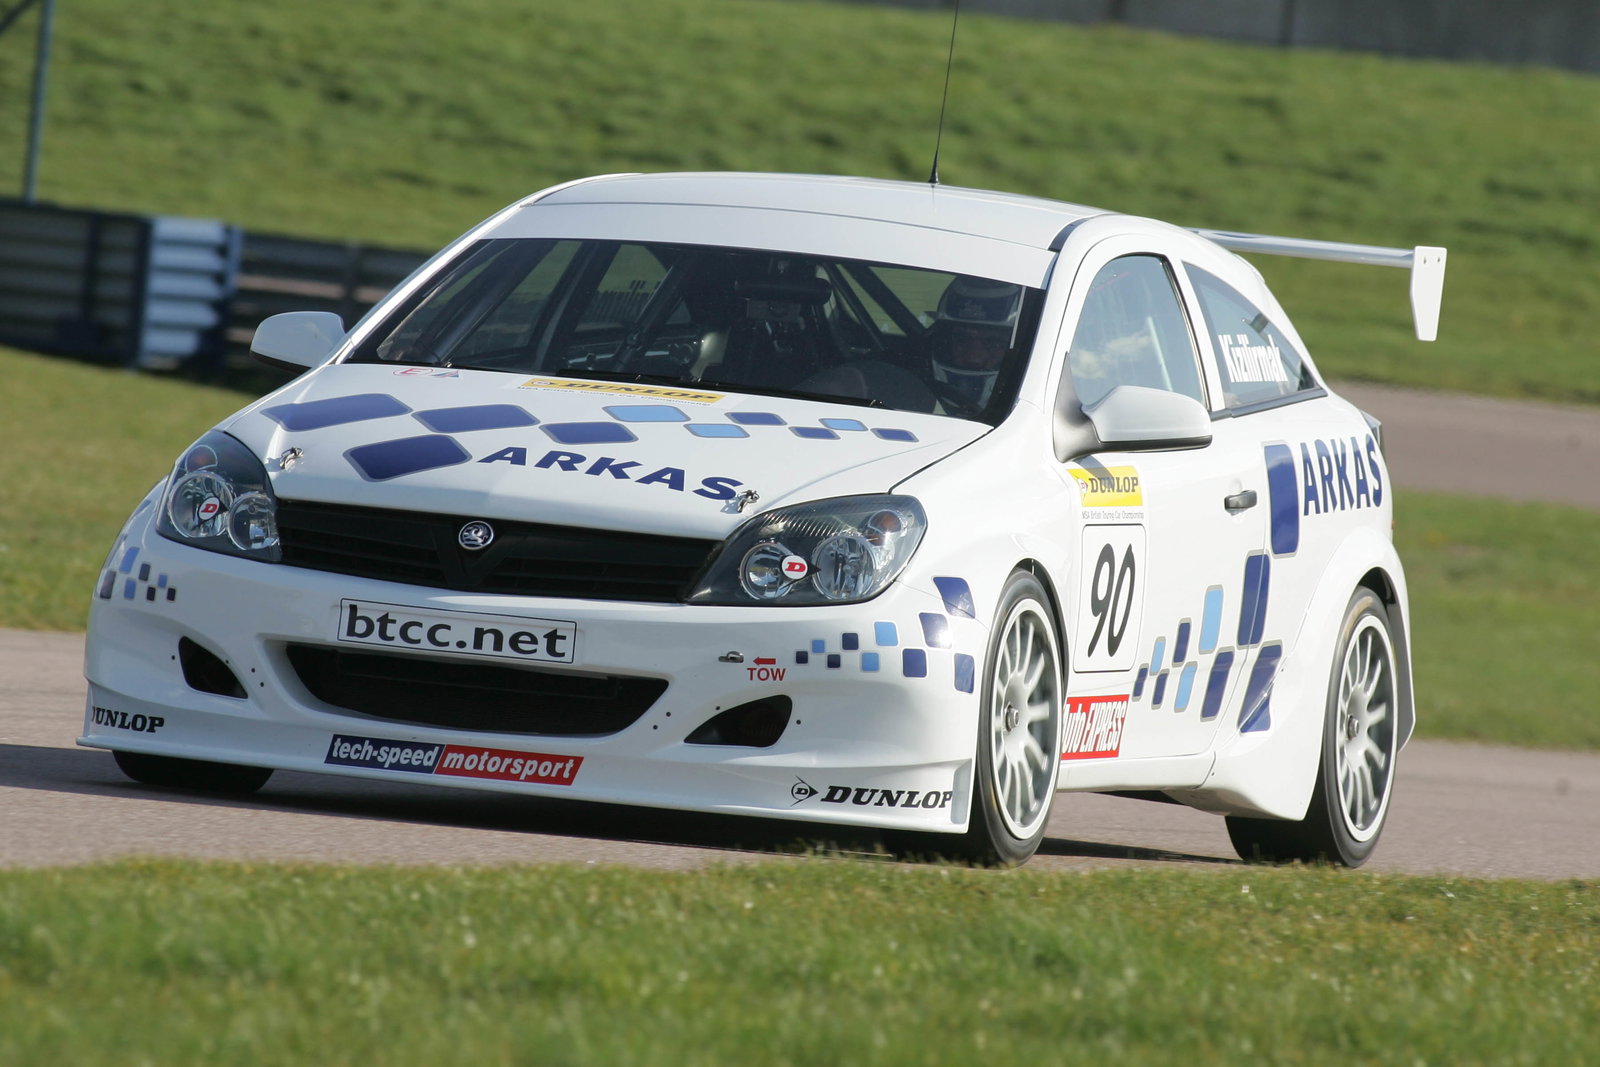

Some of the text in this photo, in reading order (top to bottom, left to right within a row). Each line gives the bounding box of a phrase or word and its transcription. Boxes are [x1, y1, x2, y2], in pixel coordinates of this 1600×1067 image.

[561, 383, 717, 400] DUNLOP
[477, 446, 744, 501] ARKAS
[1089, 476, 1139, 493] DUNLOP
[1300, 433, 1382, 516] ARKAS
[200, 503, 218, 513] D
[785, 562, 806, 572] D
[1087, 543, 1136, 658] 90
[346, 604, 567, 658] btcc.net
[746, 667, 786, 682] TOW
[1079, 701, 1127, 753] EXPRESS
[333, 738, 575, 780] tech-speed motorsport
[820, 785, 953, 809] DUNLOP
